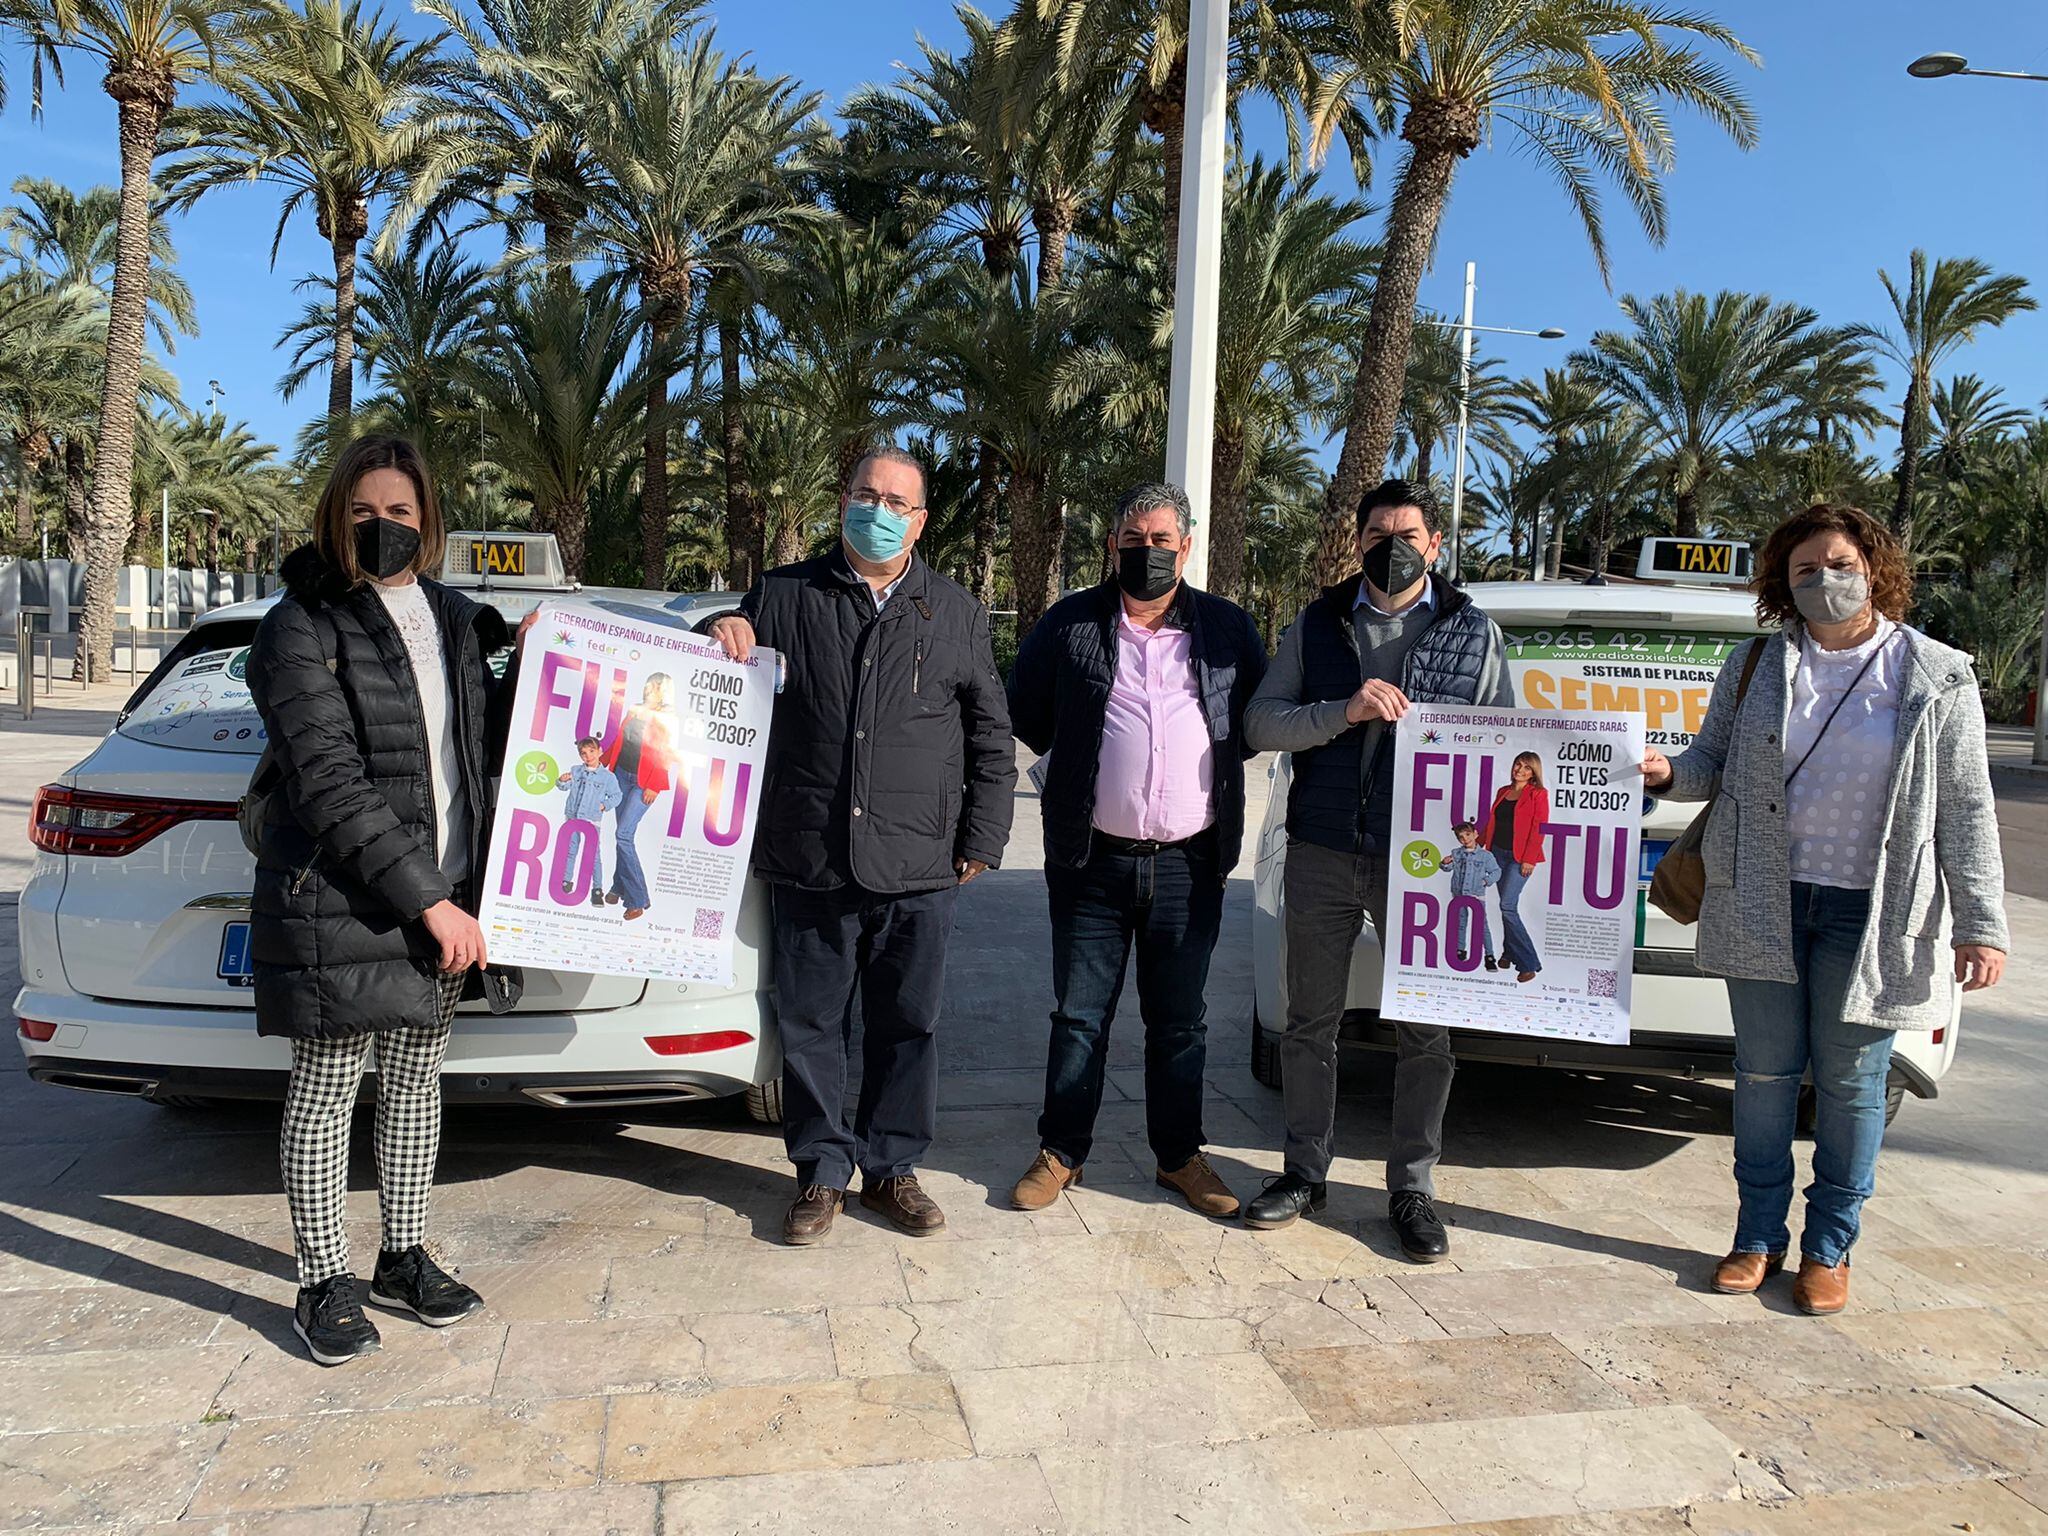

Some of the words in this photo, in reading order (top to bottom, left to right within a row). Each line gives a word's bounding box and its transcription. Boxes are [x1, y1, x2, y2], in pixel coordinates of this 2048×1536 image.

[472, 543, 524, 573] TAXI
[1676, 544, 1731, 573] TAXI
[554, 611, 607, 634] FEDERACIÓN
[608, 624, 651, 645] ESPAÑOLA
[653, 634, 665, 647] DE
[666, 638, 731, 662] ENFERMEDADES
[587, 639, 619, 655] feder
[1533, 631, 1596, 650] 965
[1607, 633, 1649, 652] 42
[1660, 634, 1697, 654] 77
[690, 669, 743, 696] ¿CÓMO
[1583, 665, 1642, 679] SISTEMA
[1644, 669, 1661, 680] DE
[1664, 669, 1715, 683] PLACAS
[529, 651, 628, 749] FU
[688, 692, 706, 714] TE
[709, 696, 738, 720] VES
[707, 721, 757, 748] 2030?
[1420, 713, 1470, 725] FEDERACIÓN
[1472, 714, 1515, 728] ESPAÑOLA
[1517, 717, 1529, 728] DE
[1530, 718, 1598, 732] ENFERMEDADES
[1600, 722, 1628, 733] RARAS
[1453, 732, 1483, 743] feder
[1557, 739, 1612, 763] ¿CÓMO
[1556, 765, 1574, 784] TE
[1578, 766, 1609, 786] VES
[667, 753, 753, 848] TU
[1410, 752, 1494, 838] FU
[1555, 789, 1576, 808] EN
[1579, 790, 1630, 811] 2030?
[499, 808, 599, 906] RO
[1539, 823, 1629, 910] TU
[1400, 891, 1486, 972] RO
[228, 954, 237, 966] E
